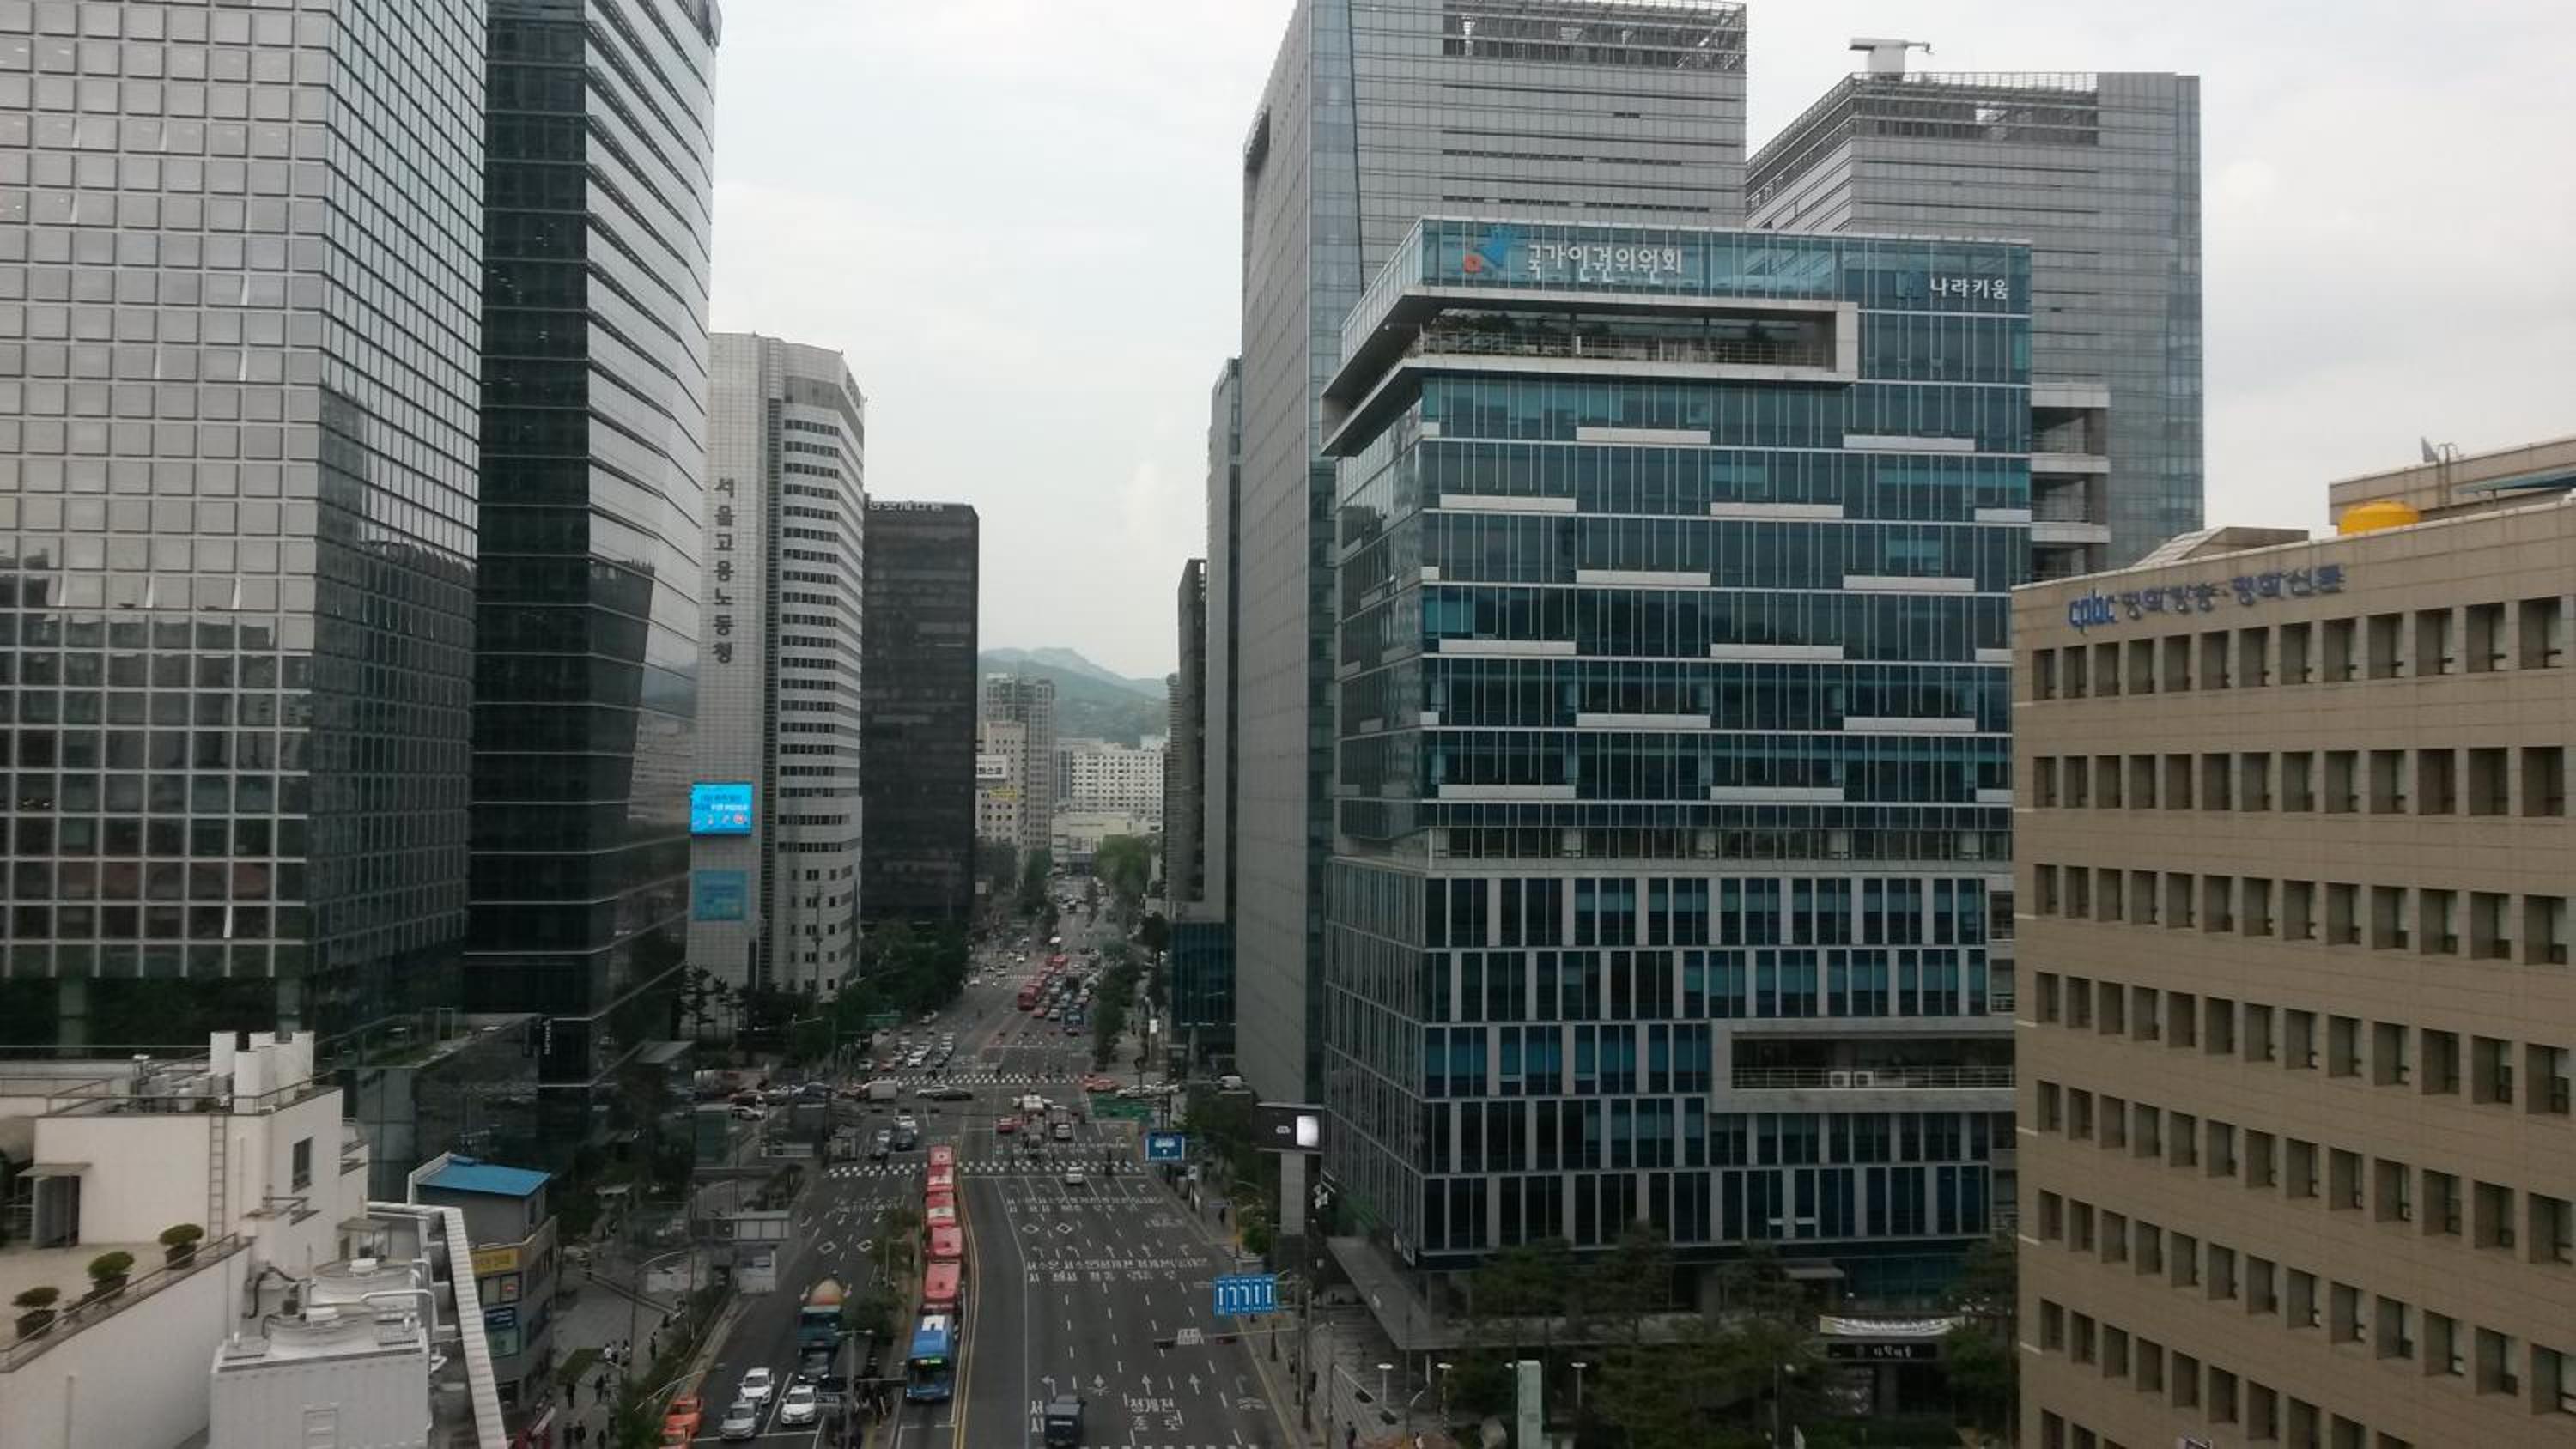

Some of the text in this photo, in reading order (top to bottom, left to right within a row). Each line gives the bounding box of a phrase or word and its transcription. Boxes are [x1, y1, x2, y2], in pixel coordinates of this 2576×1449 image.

[1528, 244, 1682, 284] 국가인권위원회
[1929, 276, 2009, 300] 나라키움
[713, 477, 736, 664] 서울고용노동청
[2069, 588, 2116, 634] cpbc
